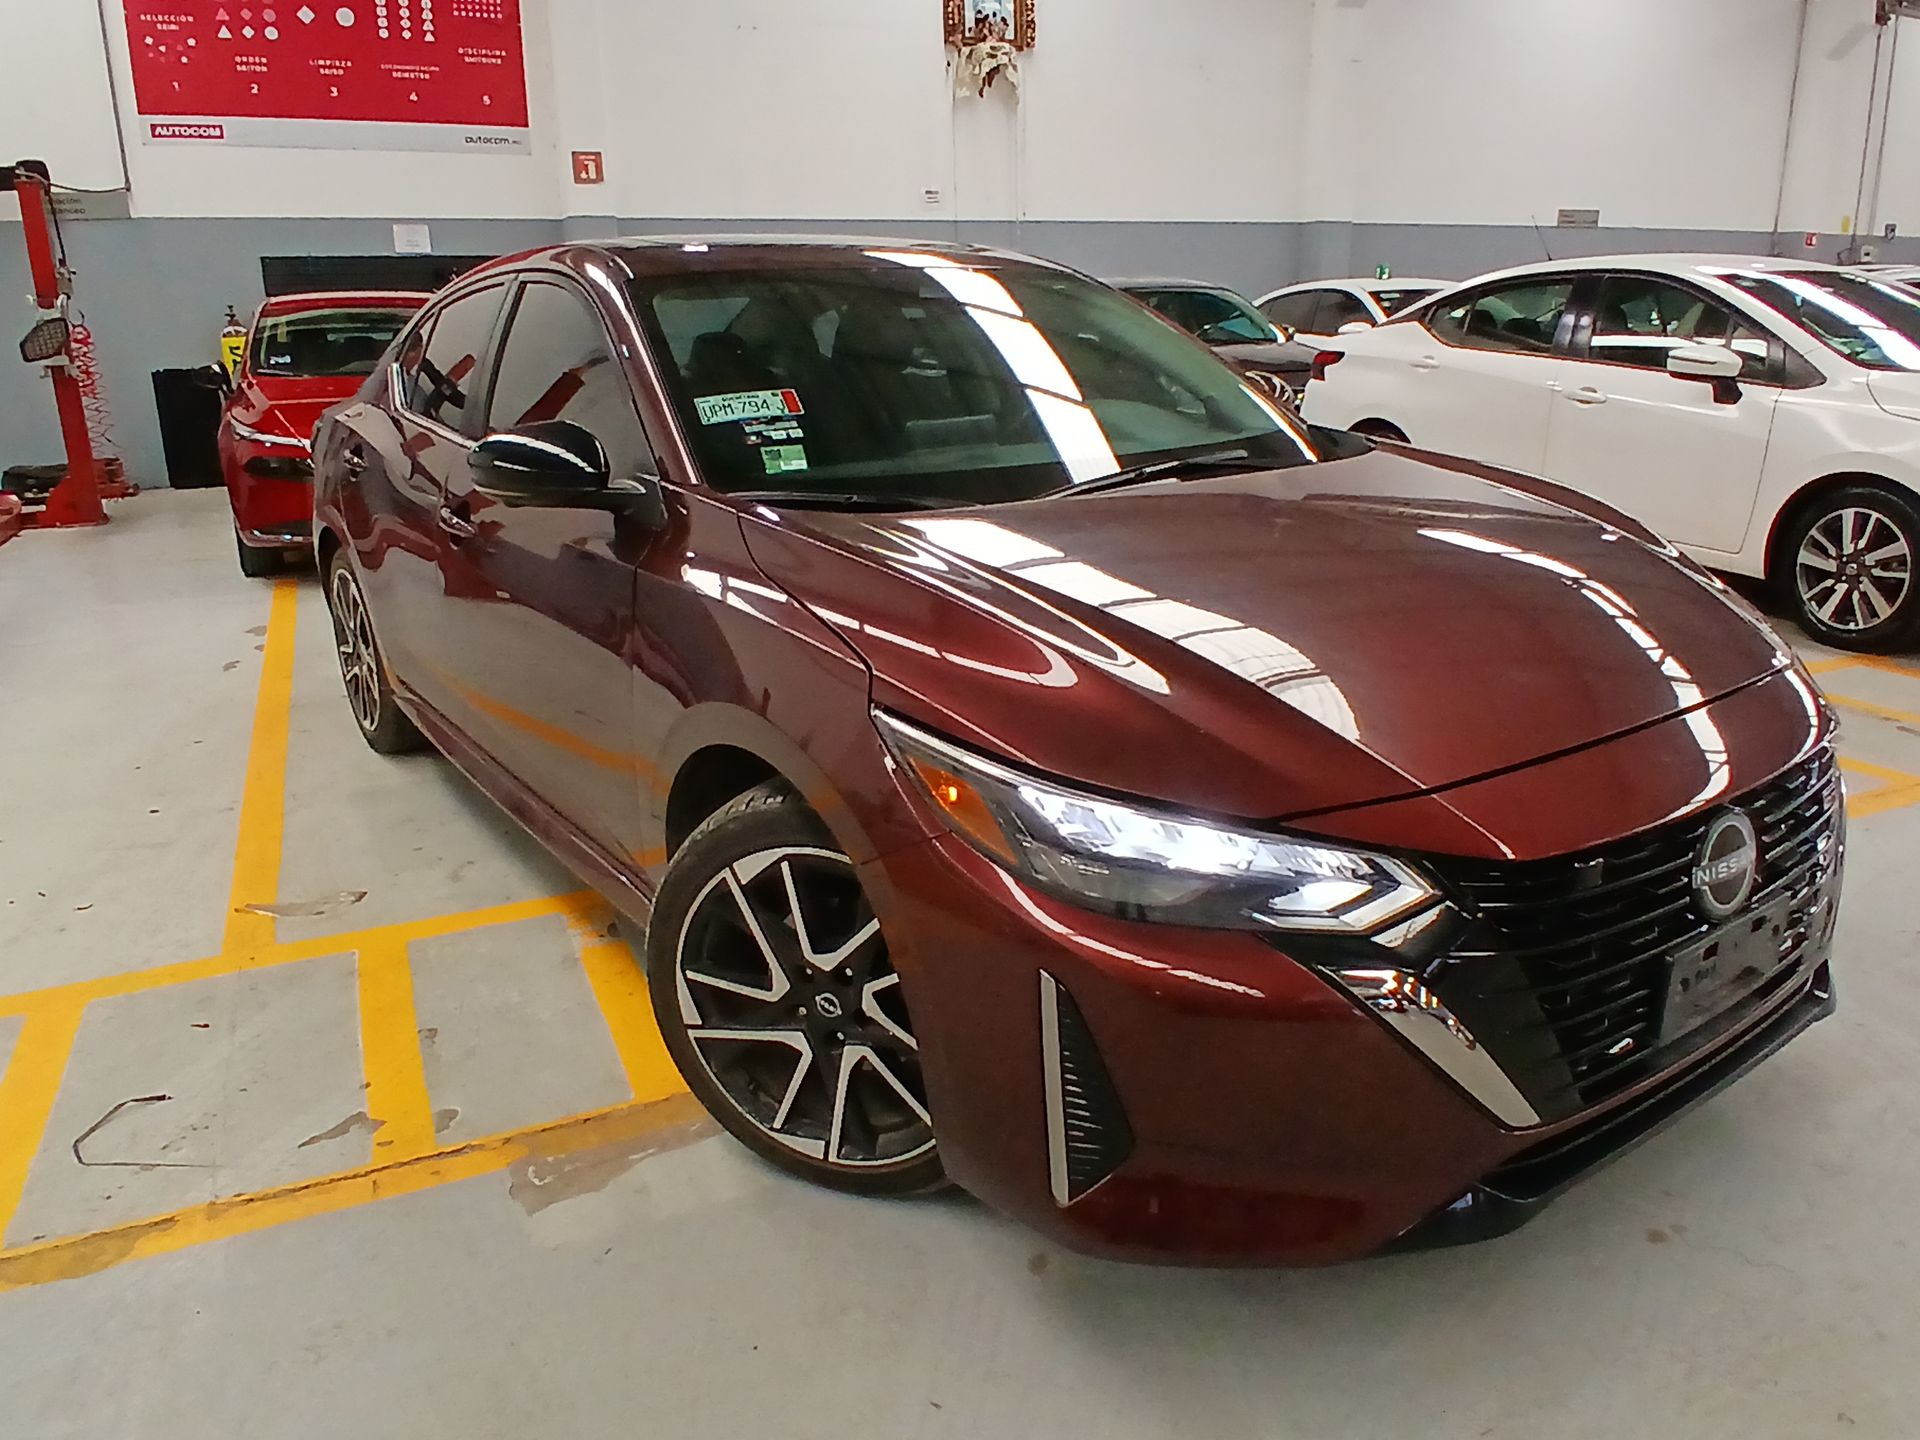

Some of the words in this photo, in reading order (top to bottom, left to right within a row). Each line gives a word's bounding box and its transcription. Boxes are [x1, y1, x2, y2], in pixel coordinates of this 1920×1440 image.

[172, 81, 180, 91] 1
[250, 83, 259, 94] 2
[329, 86, 338, 97] 3
[409, 91, 418, 101] 4
[482, 95, 491, 105] 5
[155, 126, 221, 136] AUTOCOM
